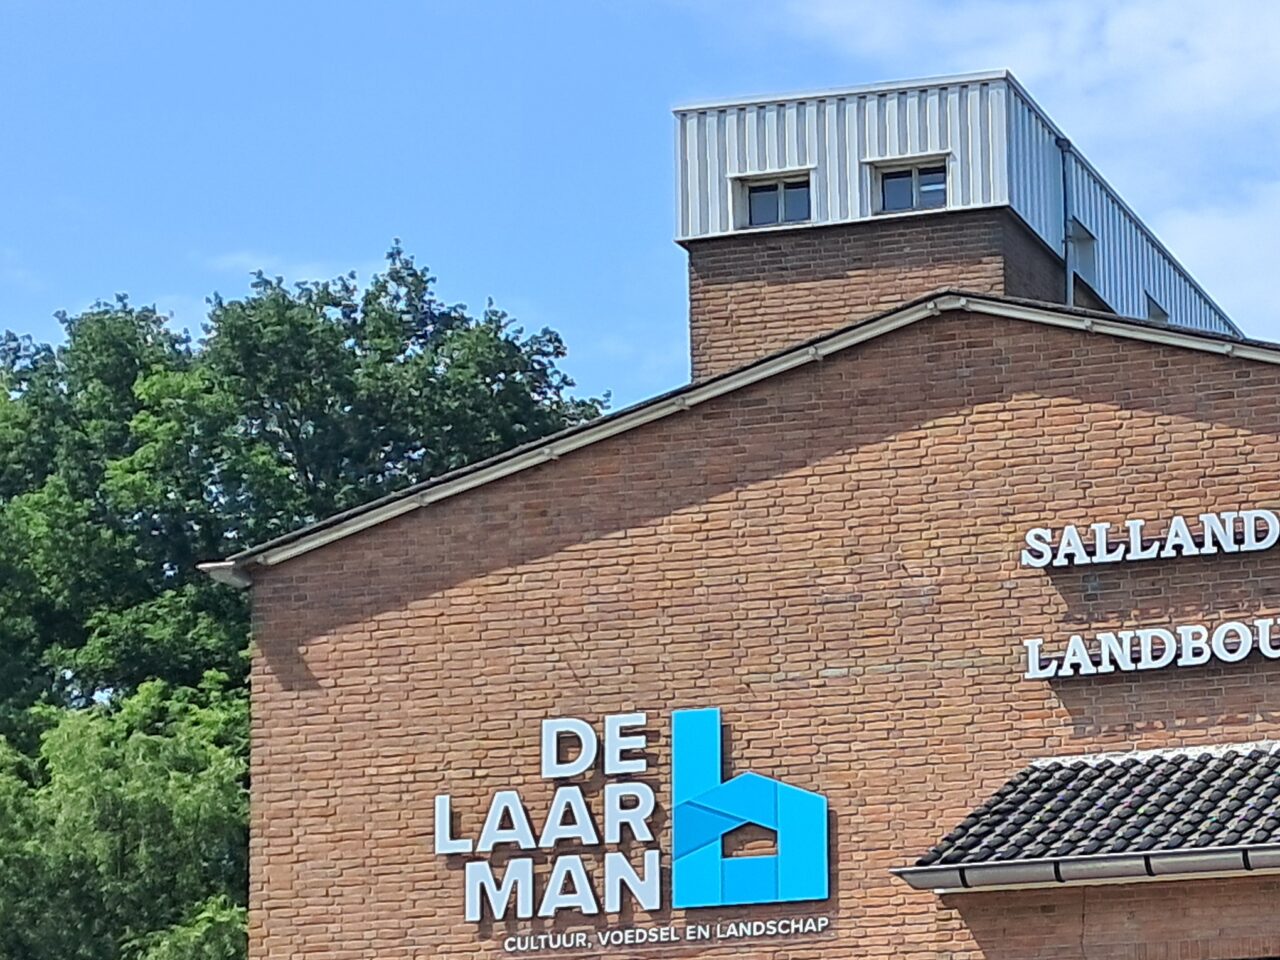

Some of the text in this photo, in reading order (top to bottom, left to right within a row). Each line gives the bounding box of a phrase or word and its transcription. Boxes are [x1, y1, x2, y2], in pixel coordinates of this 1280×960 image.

[540, 712, 648, 779] DE
[434, 781, 656, 855] LAAR
[464, 849, 661, 922] MAN
[503, 916, 830, 952] CULTUUR, VOEDSEL EN LANDSCHAP
